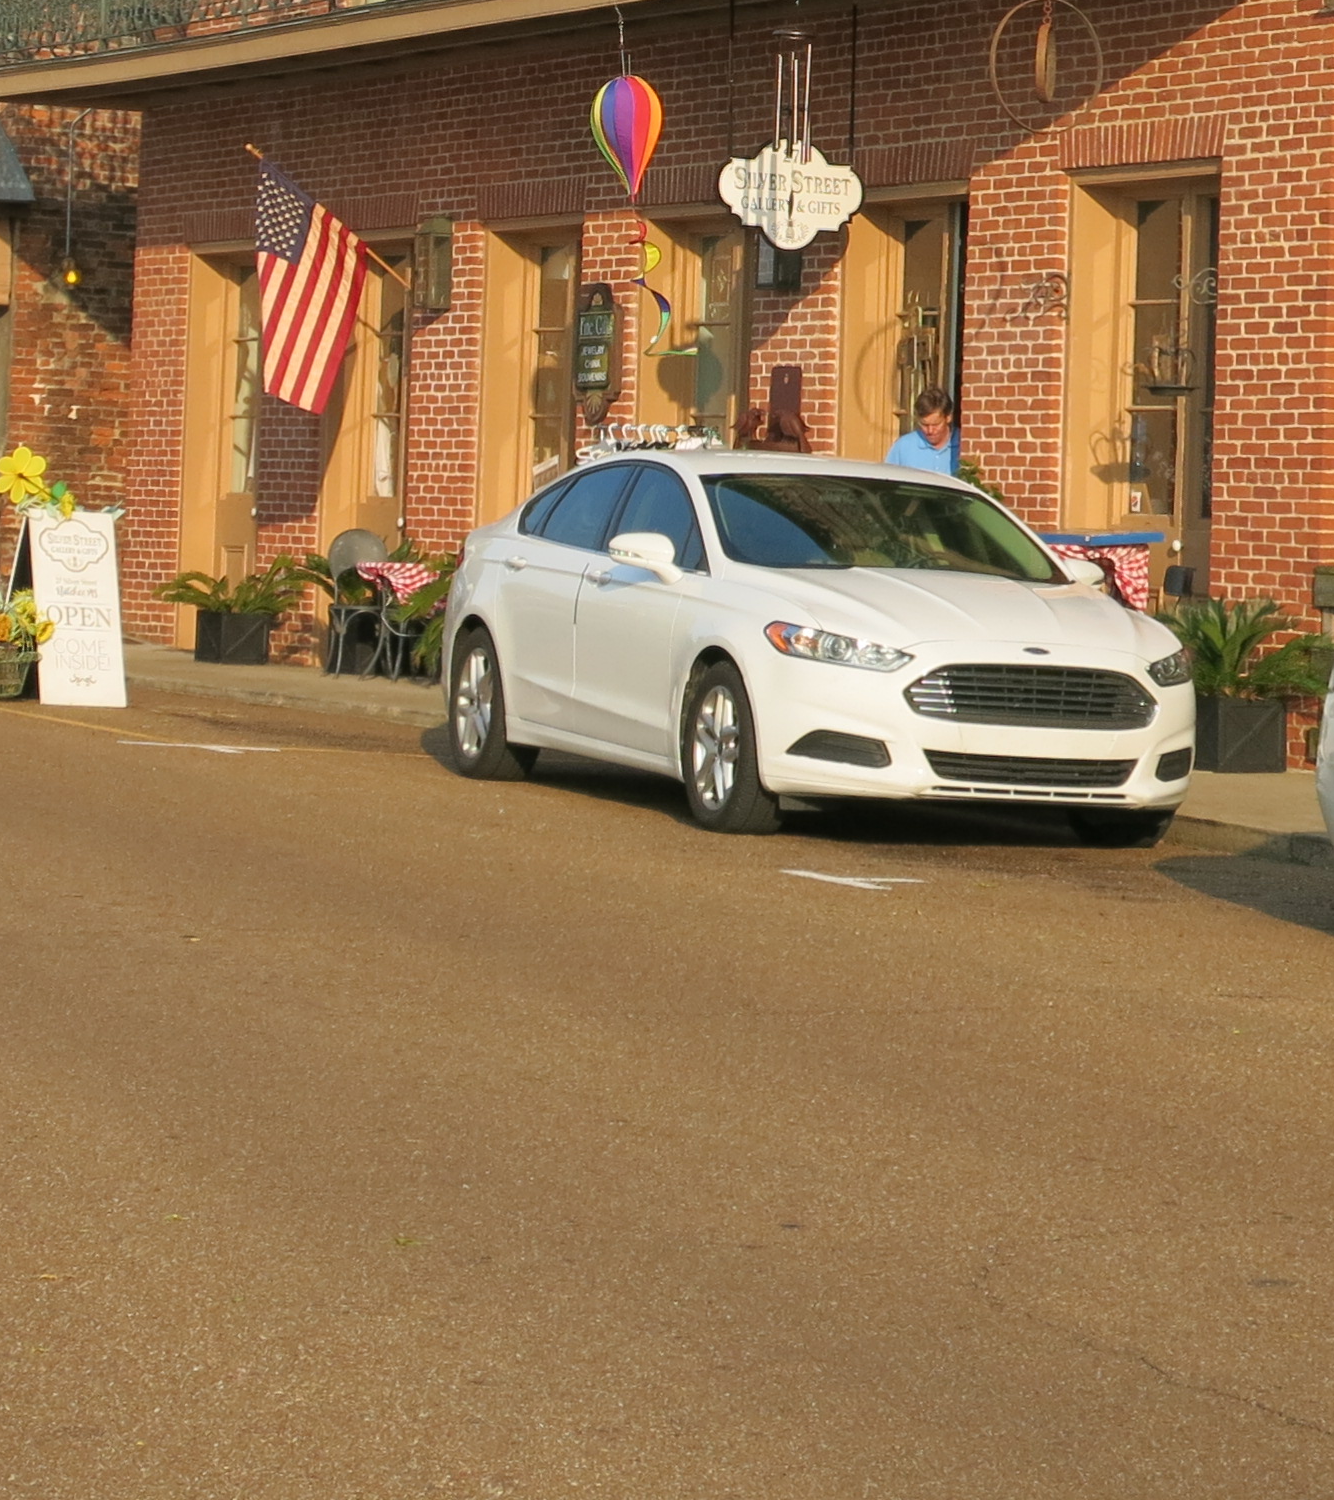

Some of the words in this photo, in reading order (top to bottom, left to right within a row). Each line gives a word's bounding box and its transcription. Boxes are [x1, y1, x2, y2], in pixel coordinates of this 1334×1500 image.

[734, 166, 787, 192] SILVER
[791, 169, 851, 196] STREET
[741, 195, 791, 212] GALLERY
[796, 200, 805, 213] &
[807, 199, 842, 215] GIFTS
[46, 604, 112, 628] OPEN
[52, 637, 108, 656] COME
[54, 653, 111, 672] INSIDE!
